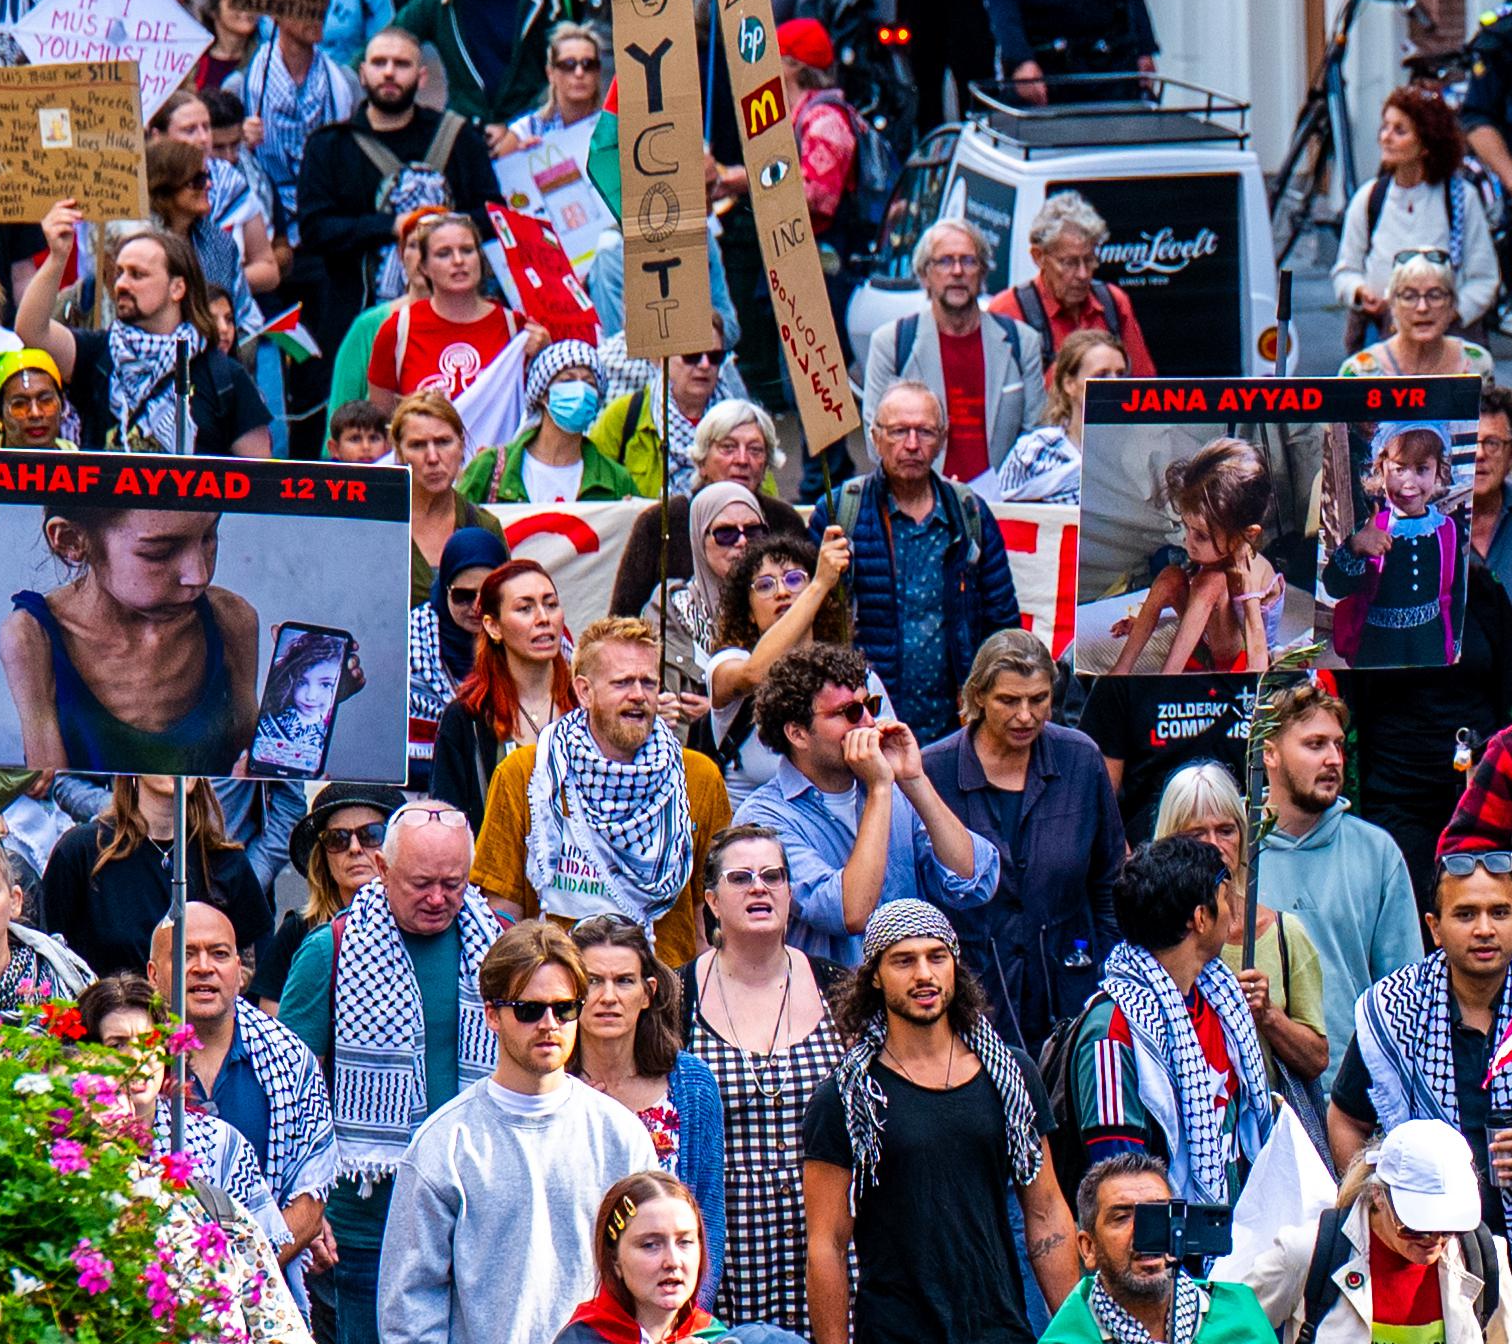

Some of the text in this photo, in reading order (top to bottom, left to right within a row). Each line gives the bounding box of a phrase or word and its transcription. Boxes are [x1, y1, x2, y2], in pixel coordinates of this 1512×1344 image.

[51, 10, 178, 43] MUST DIE
[740, 11, 766, 64] hp
[34, 34, 194, 74] YOU MUST LIVE
[88, 63, 122, 82] STIL
[141, 74, 173, 95] MY
[772, 218, 805, 257] ING
[1094, 238, 1147, 264] imon
[769, 269, 838, 386] BOYCOTT
[781, 324, 843, 422] DIVEST
[1122, 387, 1426, 413] JANA AYYAD 8 YR
[114, 467, 251, 501] AYYAD
[280, 477, 316, 501] 12
[324, 479, 367, 503] YR
[1157, 702, 1230, 720] ZOLDERK
